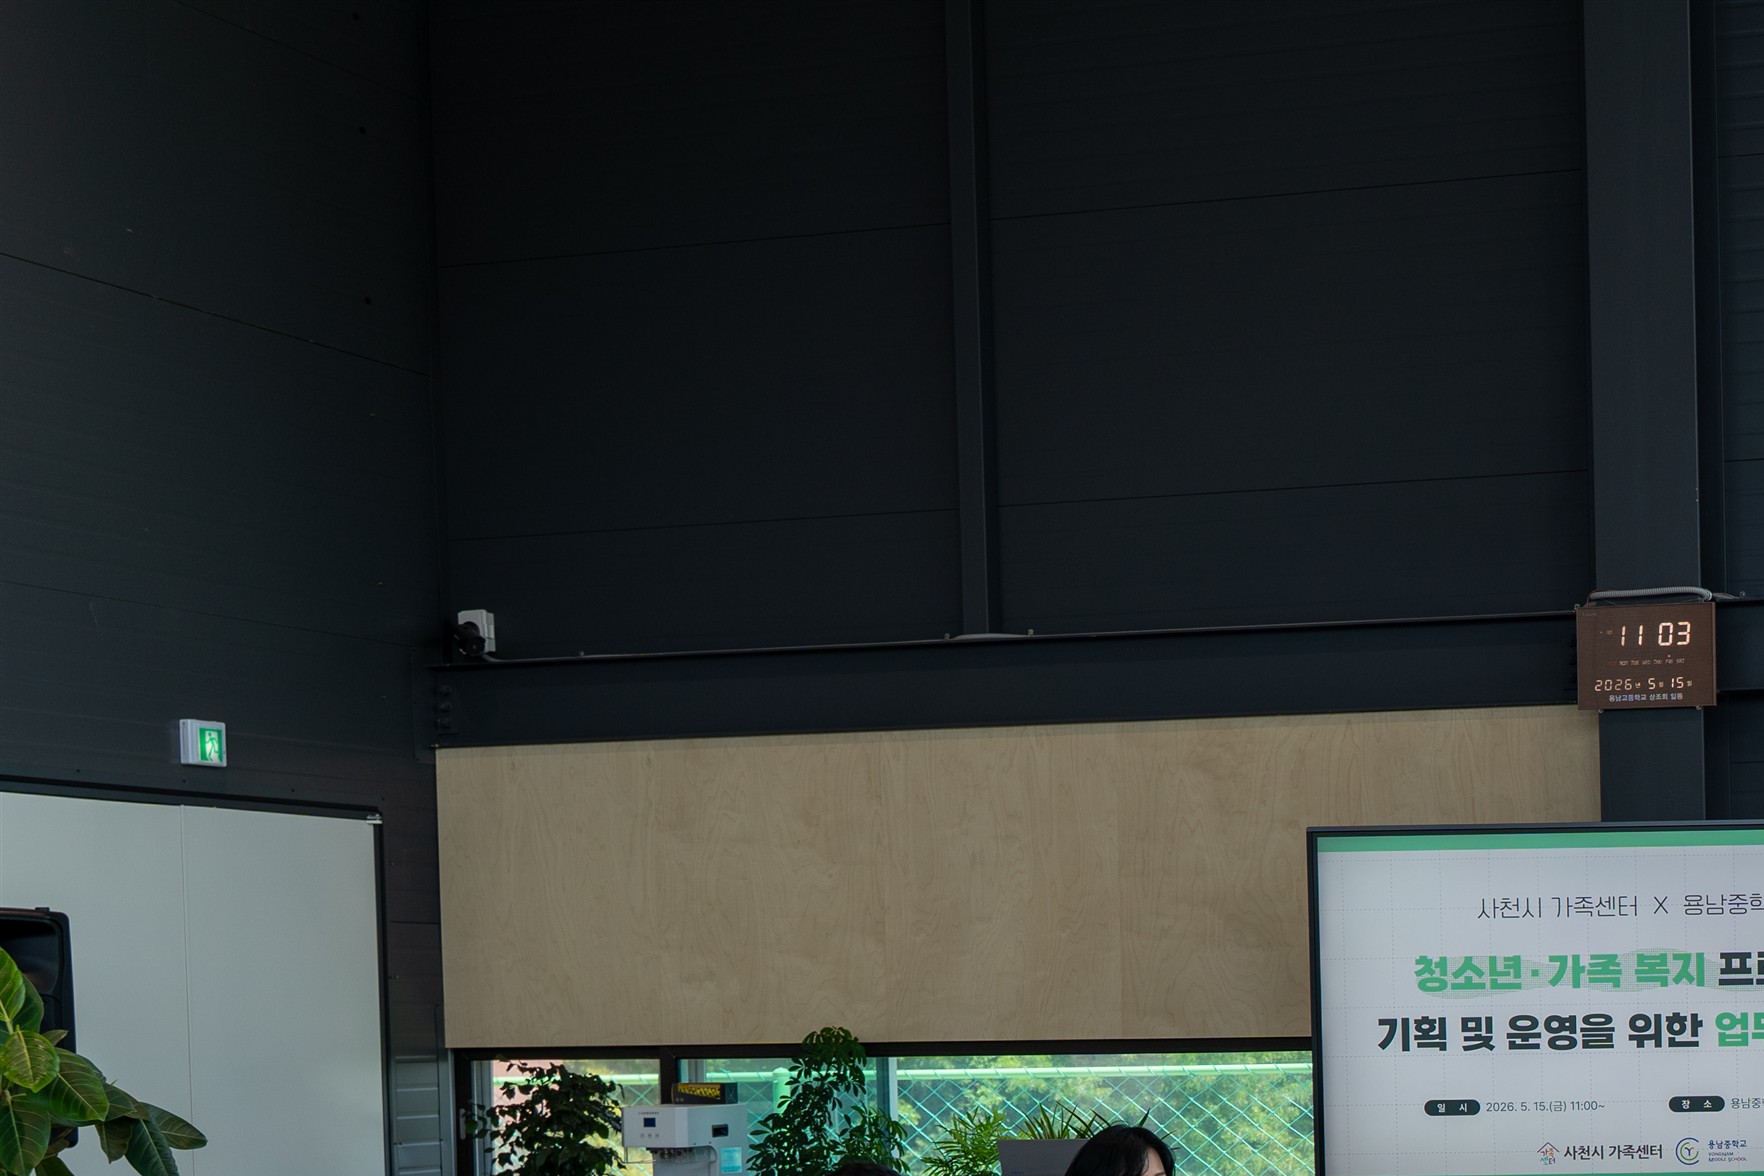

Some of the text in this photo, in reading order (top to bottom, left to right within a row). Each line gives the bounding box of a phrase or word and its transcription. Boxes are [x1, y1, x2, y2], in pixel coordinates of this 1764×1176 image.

[1658, 621, 1691, 646] 03
[1477, 896, 1542, 920] 사천시
[1551, 895, 1638, 918] 가족센터
[1634, 952, 1706, 988] 복지
[1378, 1015, 1448, 1052] 기획
[1460, 1016, 1496, 1052] 및
[1506, 1013, 1616, 1051] 운영을
[1628, 1011, 1704, 1049] 위한
[1486, 1100, 1606, 1112] 2026. 5. 15.(금) 11:00~
[1563, 1144, 1663, 1161] 사천시 가족센터
[1708, 1139, 1747, 1150] 용남중학교
